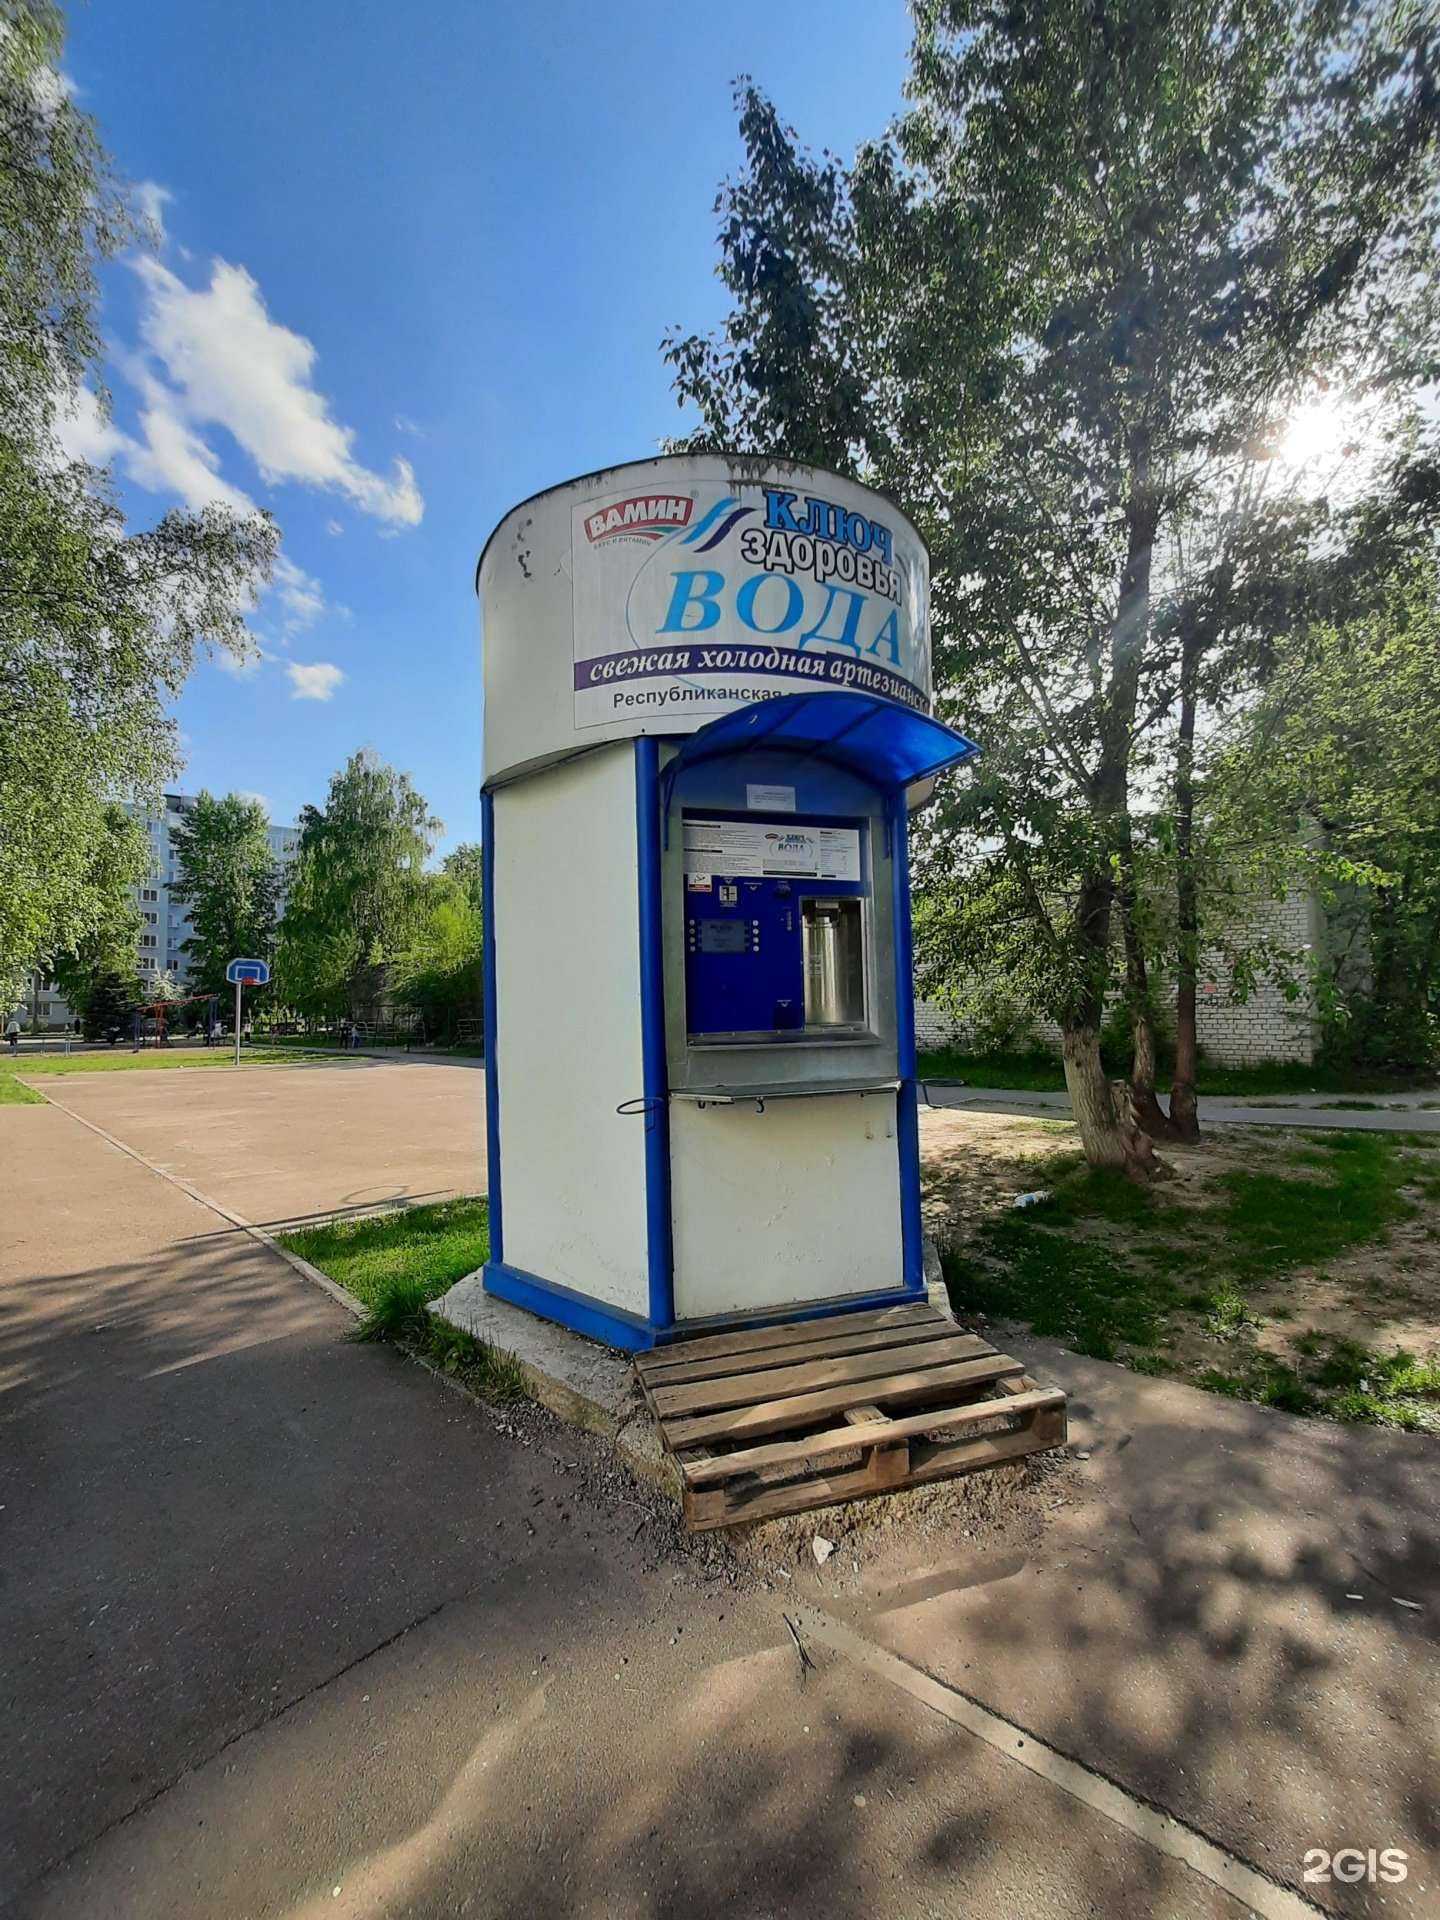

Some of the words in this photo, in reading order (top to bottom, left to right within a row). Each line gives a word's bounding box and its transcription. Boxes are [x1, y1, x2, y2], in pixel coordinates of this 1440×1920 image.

[589, 500, 688, 539] ВАМИН
[764, 490, 894, 567] КЛЮЧ
[655, 570, 903, 668] ВОДА
[590, 650, 690, 681] свежая
[698, 647, 826, 676] холодная
